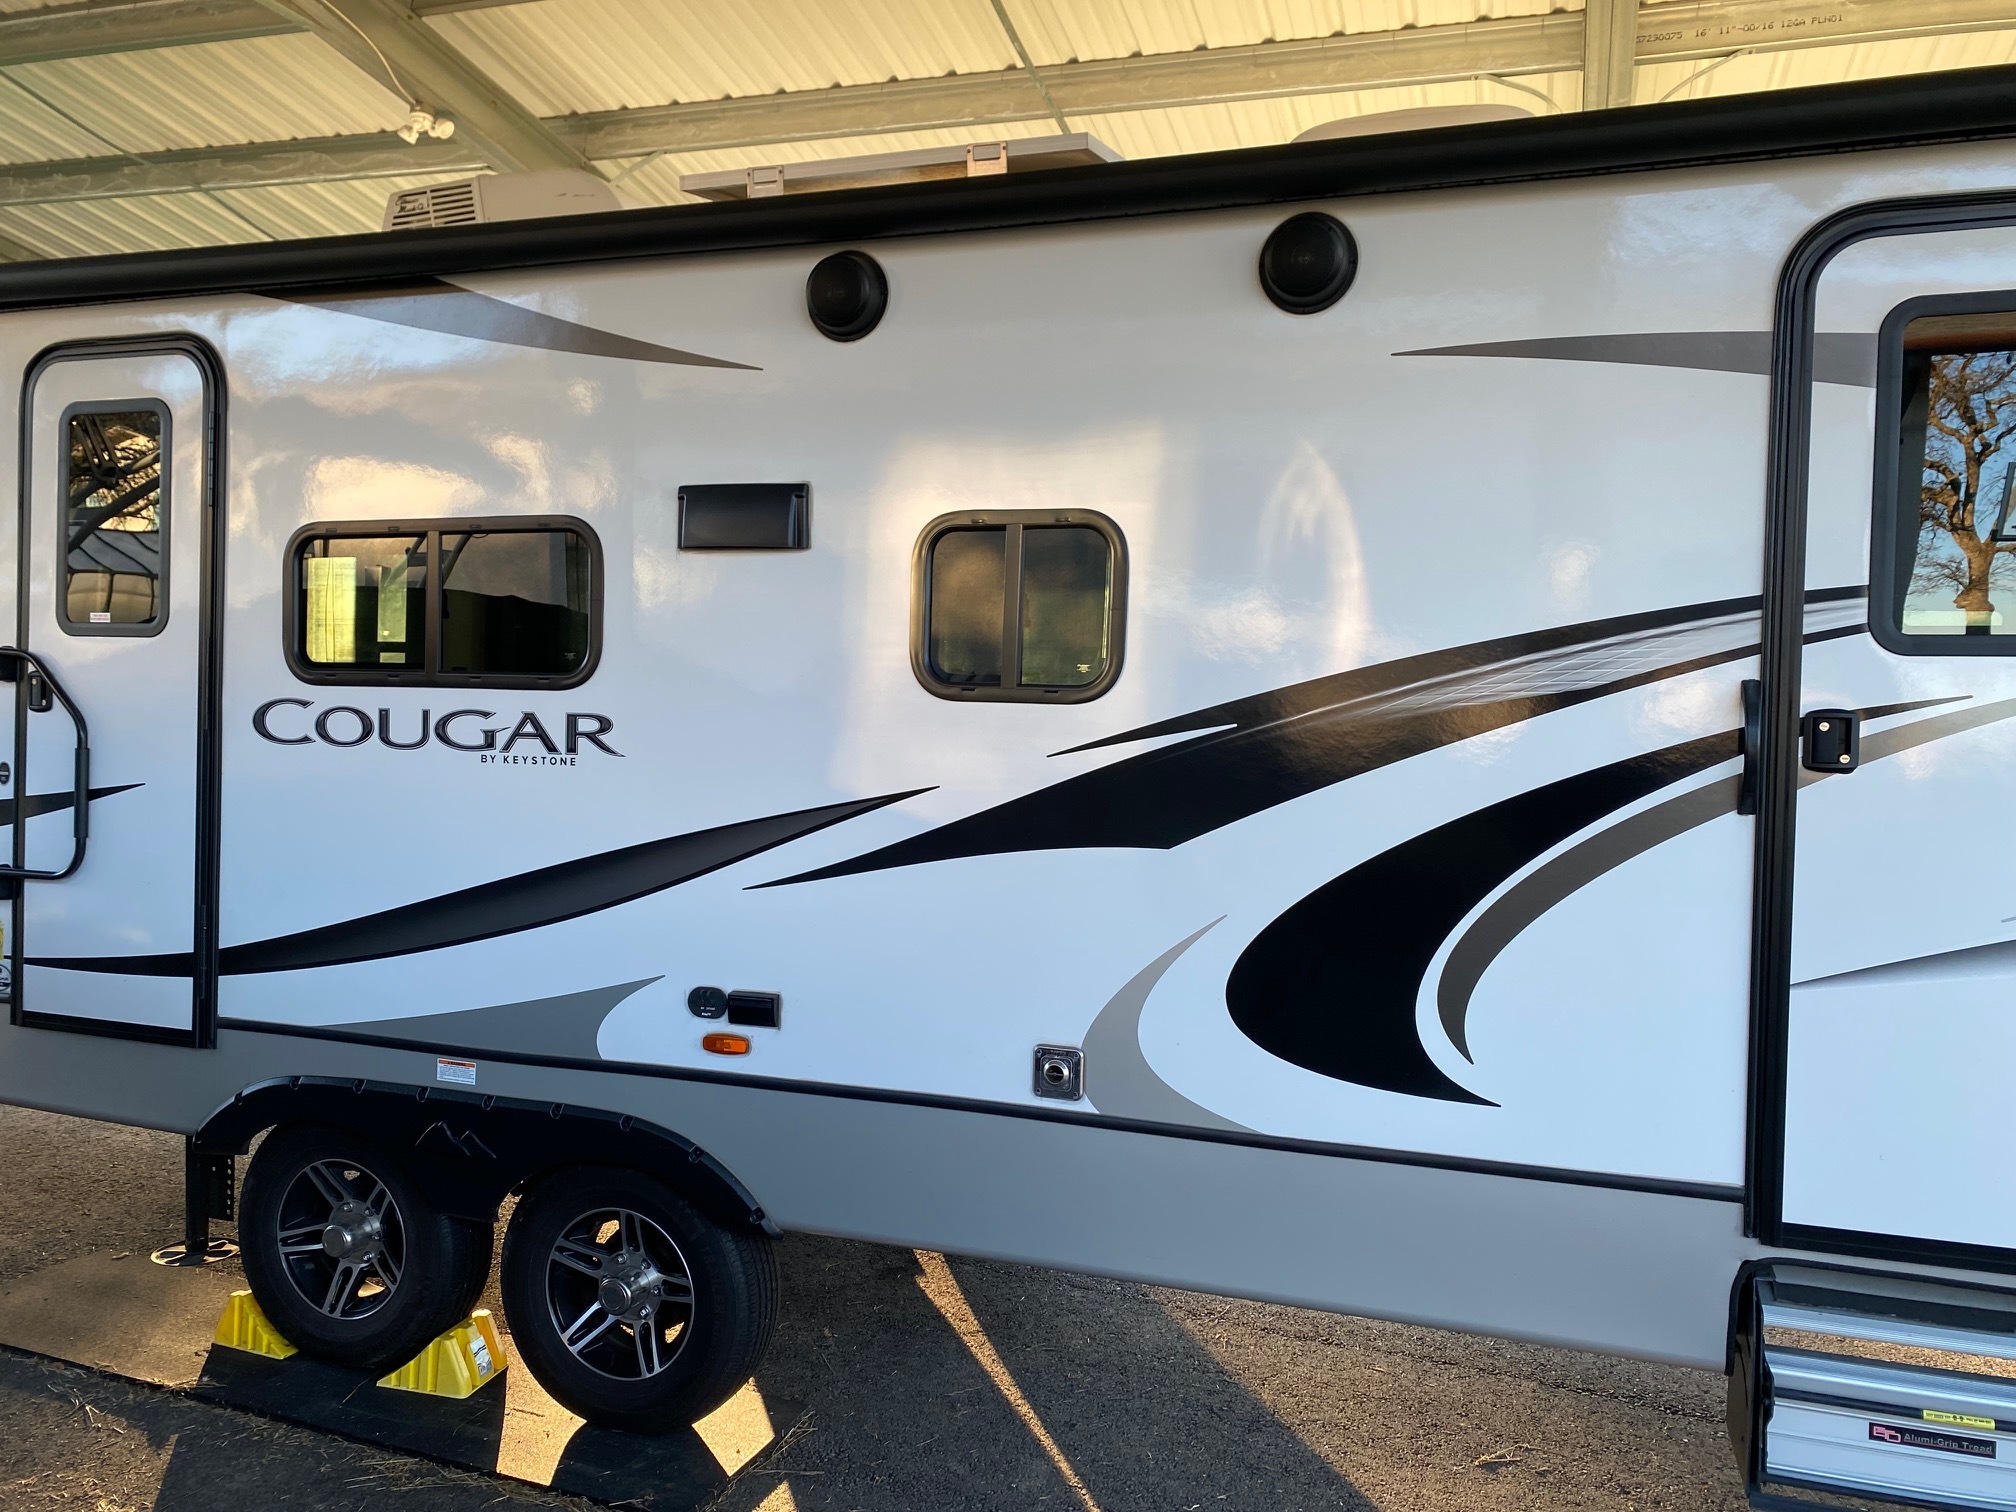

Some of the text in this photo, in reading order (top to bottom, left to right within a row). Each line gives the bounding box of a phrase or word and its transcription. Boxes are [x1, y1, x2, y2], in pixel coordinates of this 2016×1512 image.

[252, 697, 626, 757] COUGAR
[480, 754, 577, 767] BY KEYSTONE
[1904, 1433, 1959, 1449] Alumi-Grip
[1961, 1442, 1993, 1454] Tread
